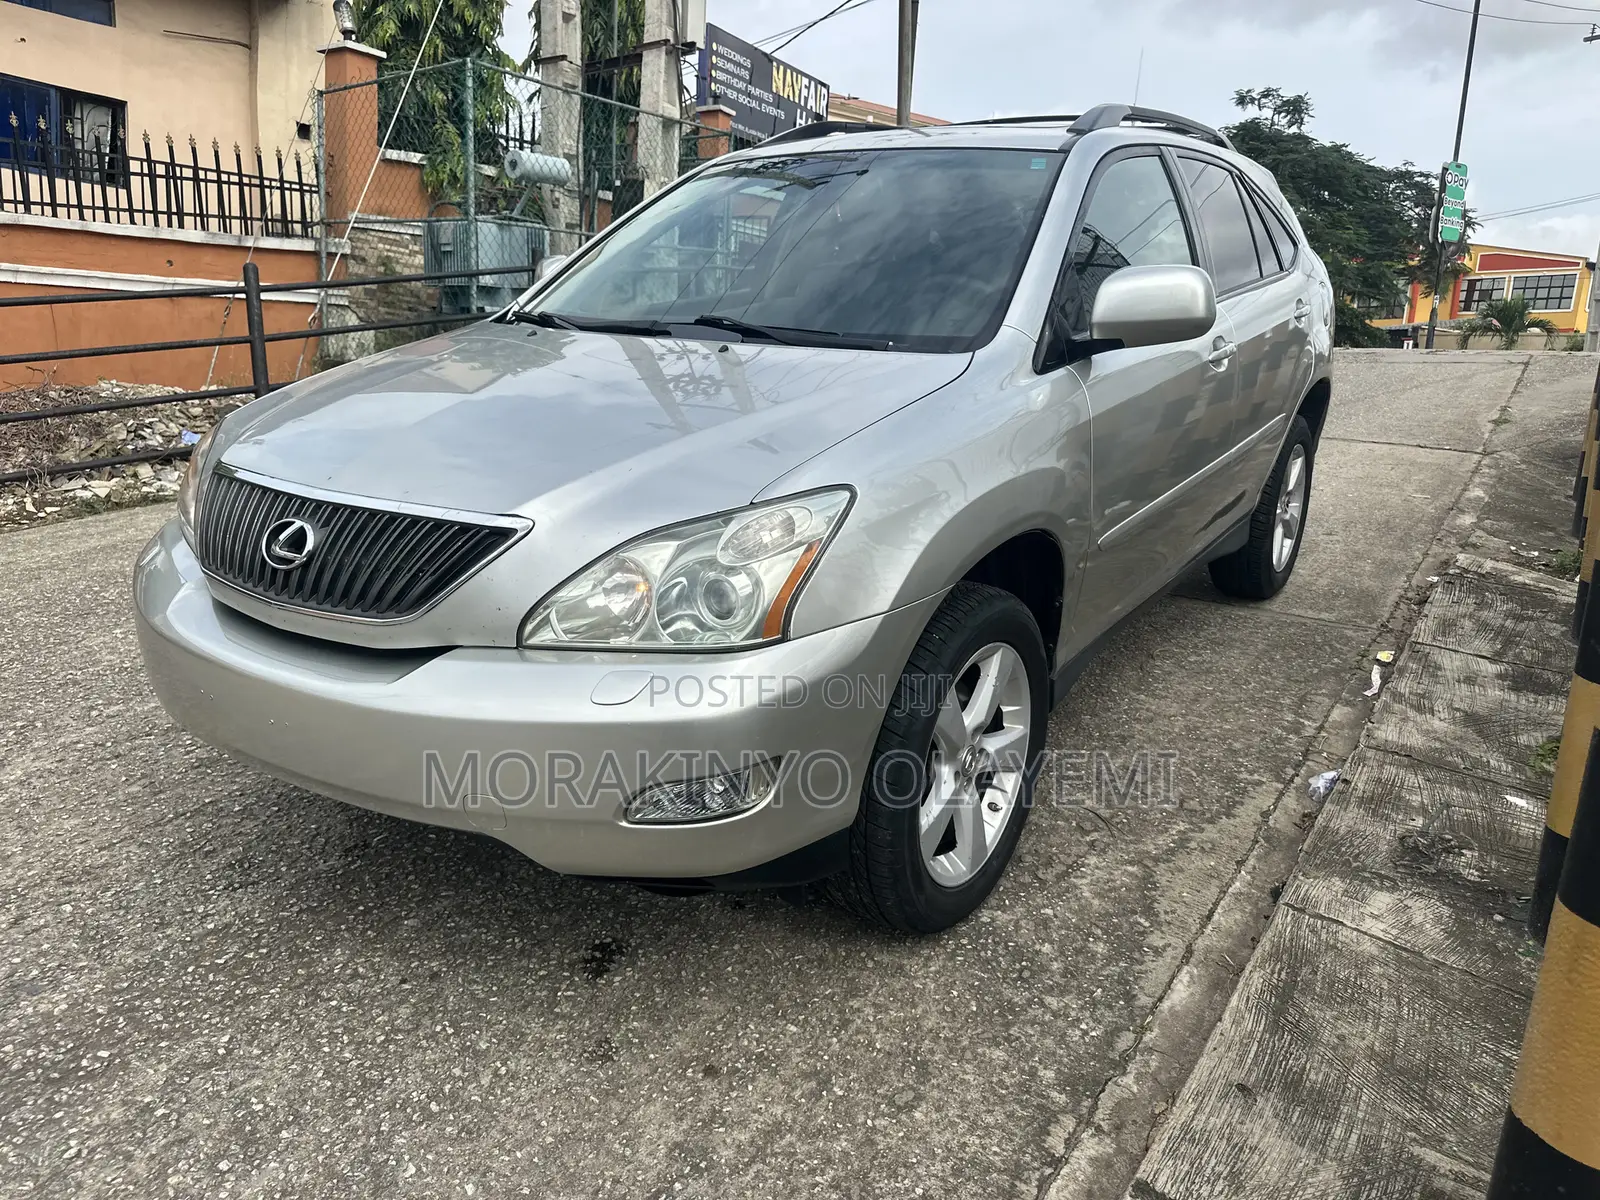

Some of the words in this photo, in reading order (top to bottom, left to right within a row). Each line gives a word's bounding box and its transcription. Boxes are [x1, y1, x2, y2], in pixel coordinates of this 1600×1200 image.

[717, 44, 751, 68] WEDDINGS
[716, 57, 750, 80] SEMINARS
[716, 70, 747, 91] BIRTHDAY
[747, 84, 773, 103] PARTIES
[715, 84, 738, 101] OTHER
[738, 93, 761, 111] SOCIAL
[761, 103, 785, 120] EVENTS
[1446, 171, 1469, 190] OPay
[1443, 196, 1465, 210] Beyond
[1440, 216, 1464, 231] Banking
